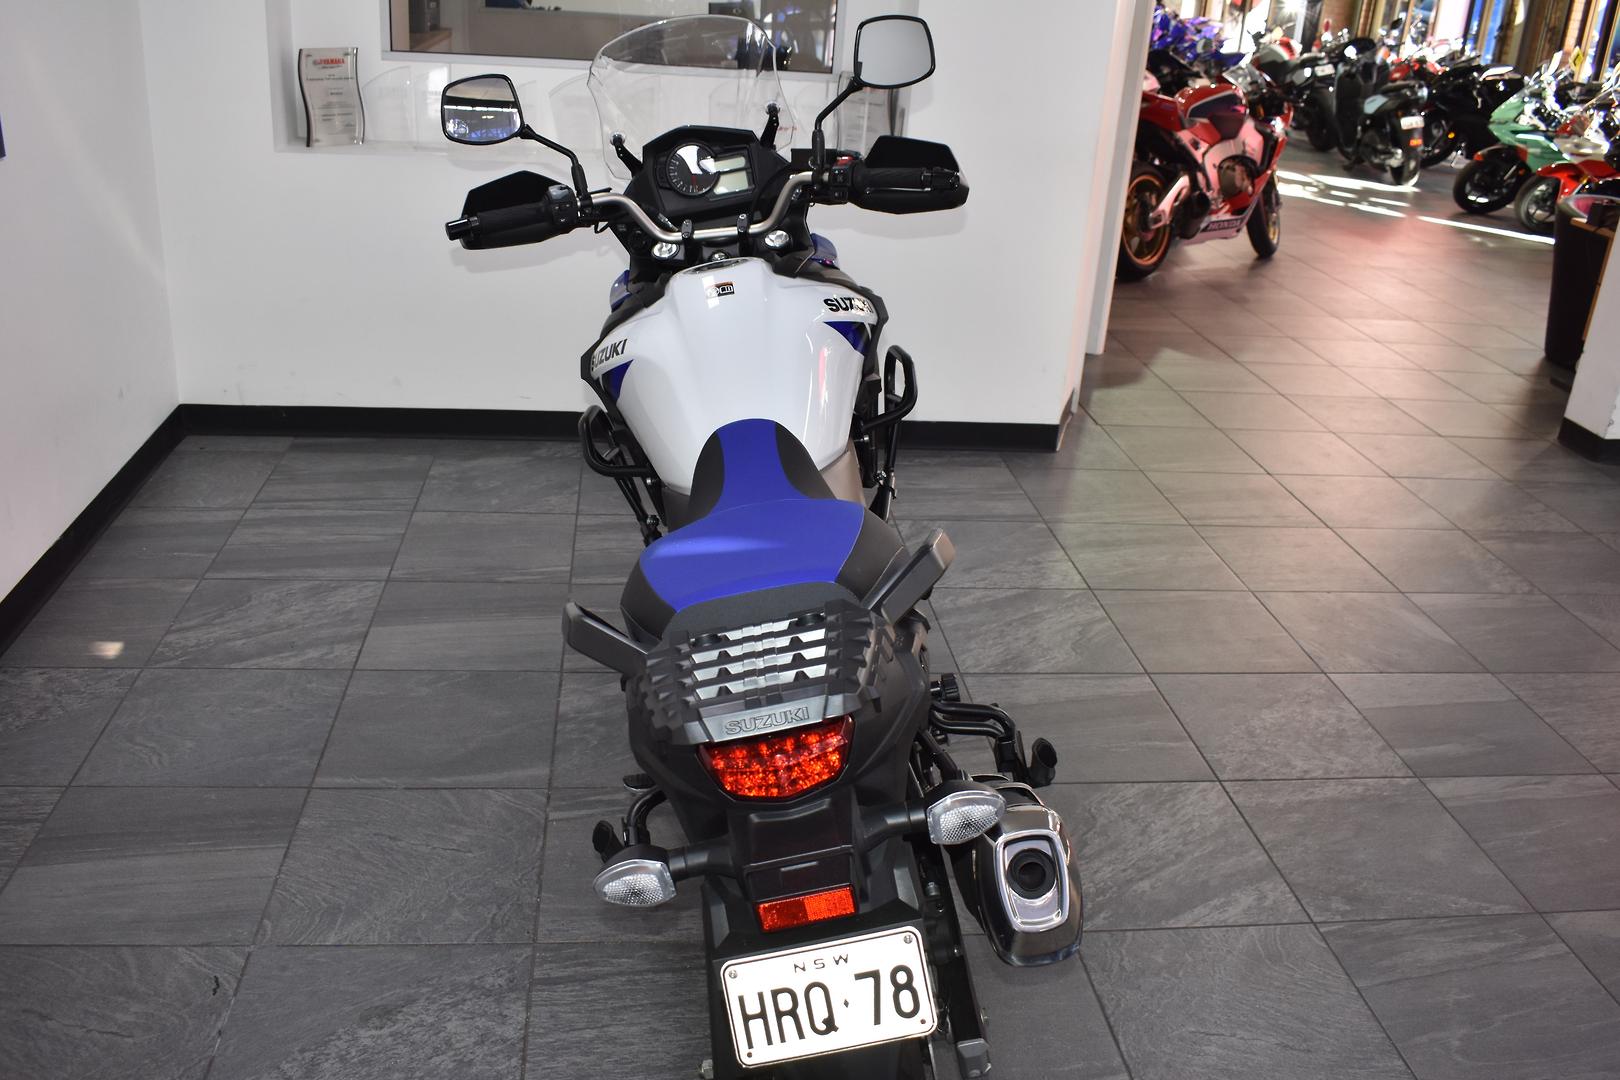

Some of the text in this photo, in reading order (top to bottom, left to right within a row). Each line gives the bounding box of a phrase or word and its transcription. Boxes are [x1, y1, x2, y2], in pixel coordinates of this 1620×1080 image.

[322, 58, 345, 66] YAMAHA
[1209, 218, 1241, 231] HONDA
[725, 707, 810, 735] SUZUKI
[794, 954, 849, 973] NSW
